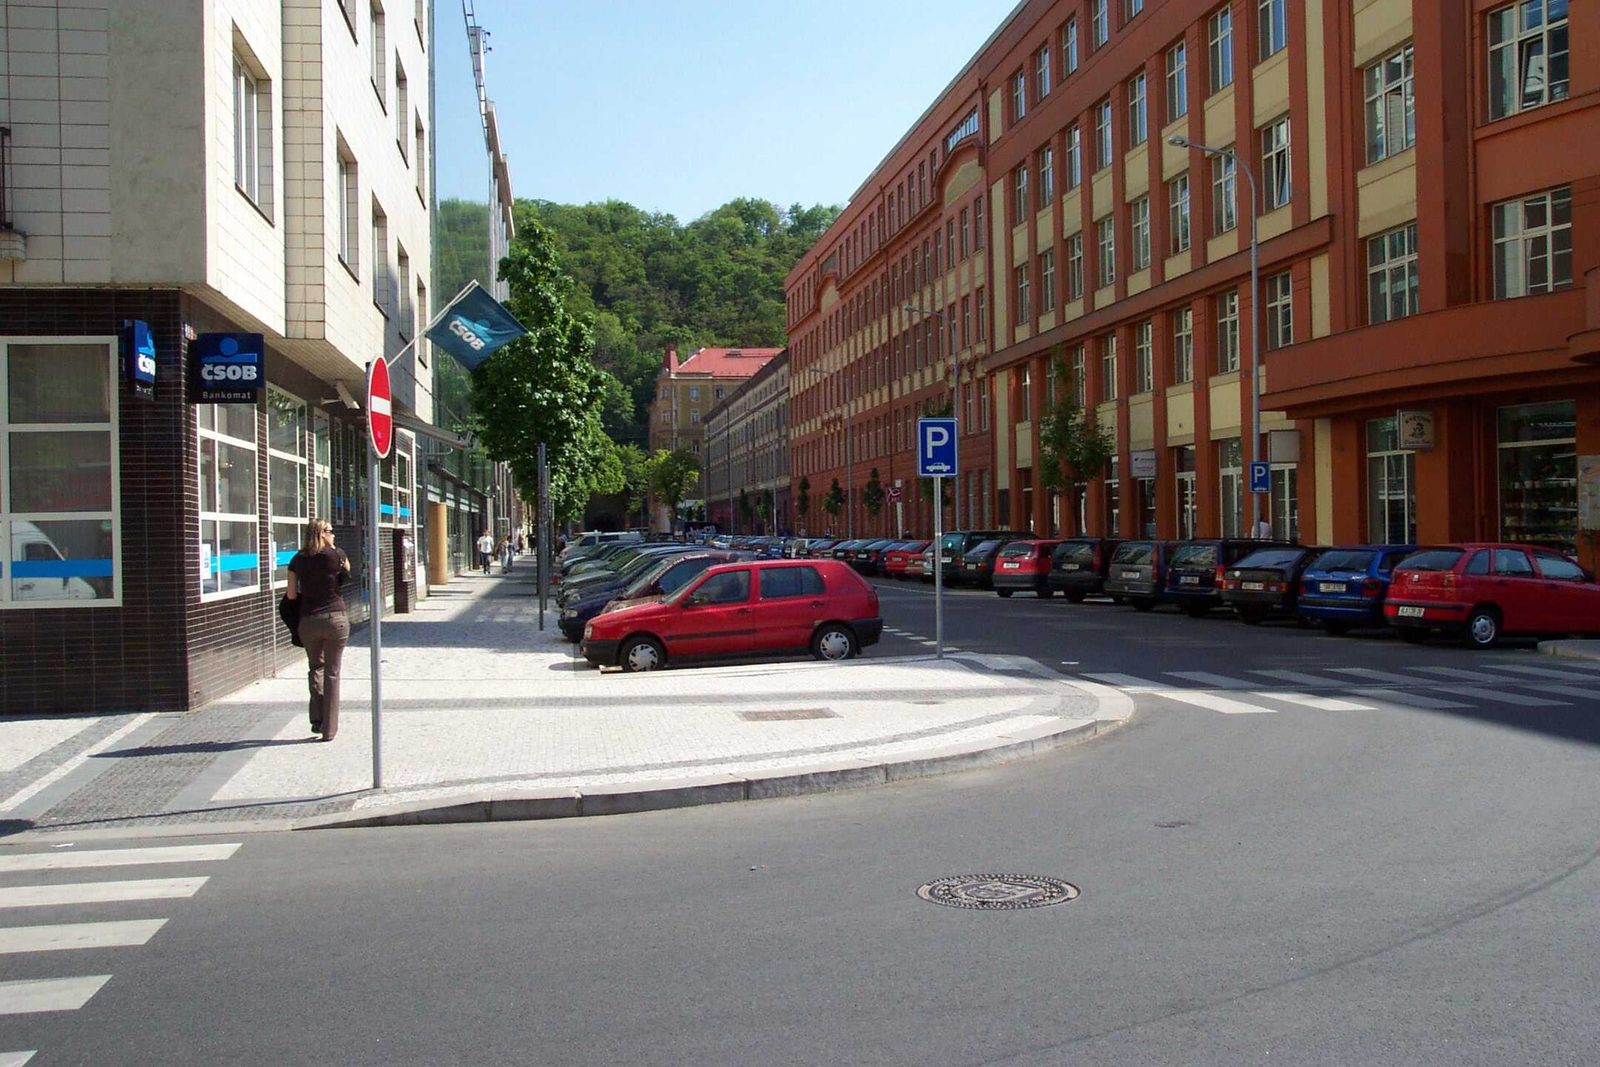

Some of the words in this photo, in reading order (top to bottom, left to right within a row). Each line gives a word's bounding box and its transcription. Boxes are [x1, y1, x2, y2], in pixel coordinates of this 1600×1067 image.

[449, 319, 486, 351] ČSOB
[138, 353, 156, 377] ČS
[201, 363, 258, 381] ČSOB
[202, 391, 252, 400] Bankomat
[926, 426, 949, 459] P
[1254, 465, 1266, 483] P
